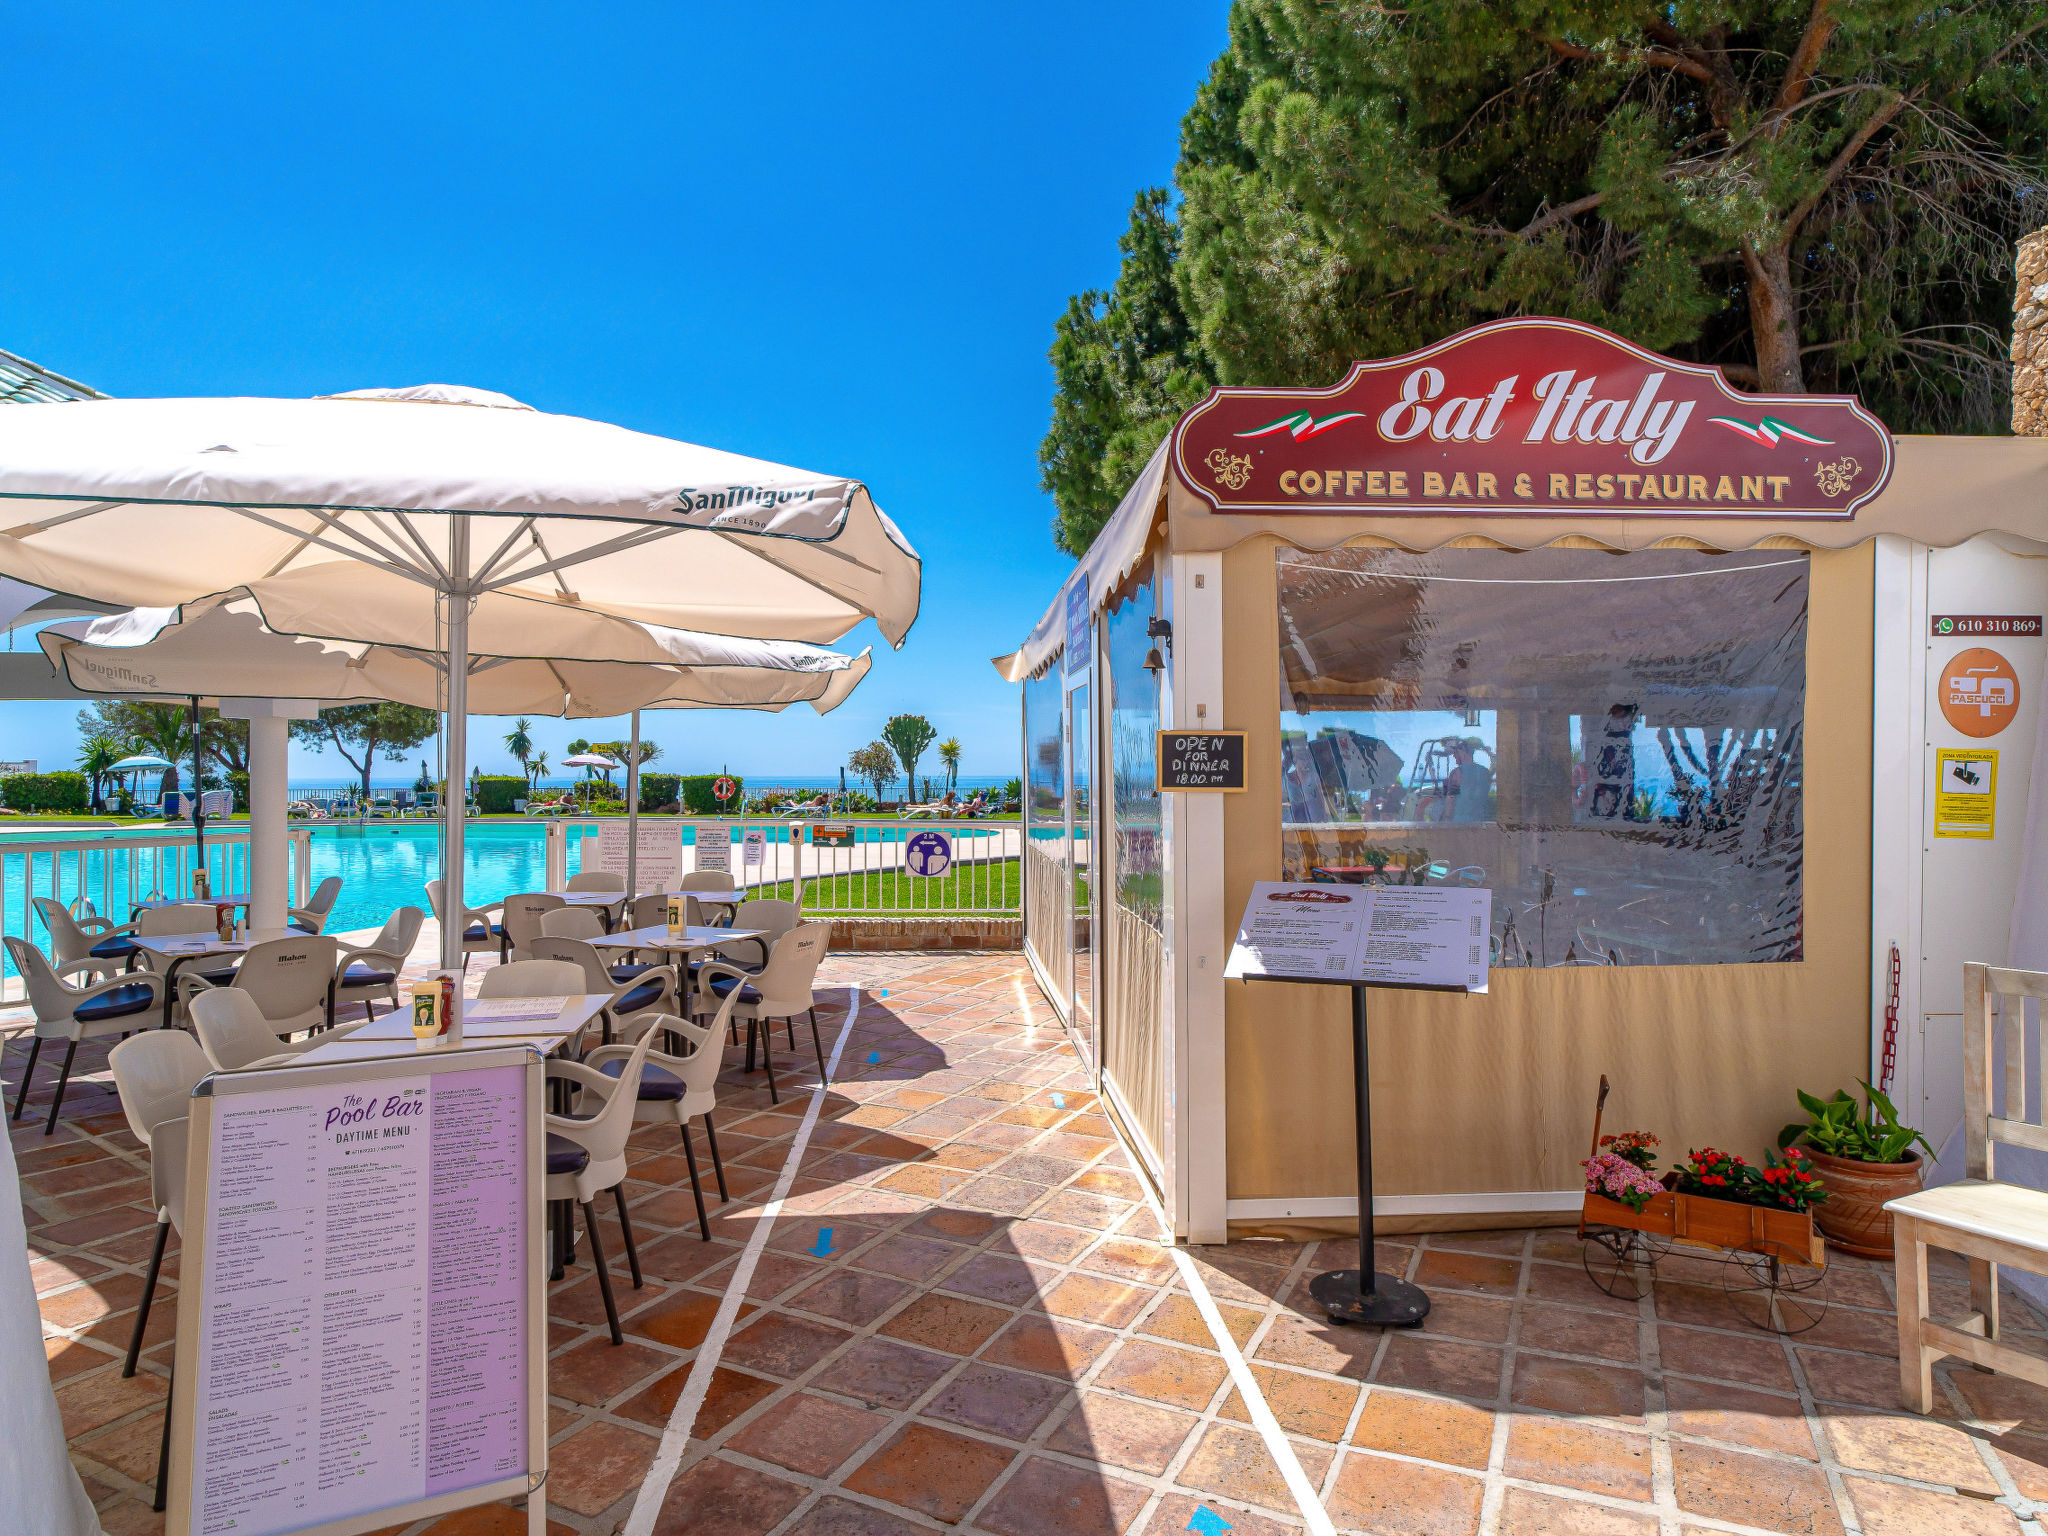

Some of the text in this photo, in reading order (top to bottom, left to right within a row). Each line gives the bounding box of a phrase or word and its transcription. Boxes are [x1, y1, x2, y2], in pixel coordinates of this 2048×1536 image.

[1378, 366, 1697, 465] Eat Italy
[1278, 469, 1791, 503] COFFEE BAR & RESTAURANT
[1958, 620, 2036, 632] 610 310 869
[790, 655, 832, 668] SanMi
[1951, 694, 2006, 705] PASCUCCI
[1175, 736, 1225, 752] OPEN
[1184, 751, 1209, 761] FOR
[1171, 758, 1230, 772] DINNER
[277, 954, 307, 963] Mahou
[343, 1094, 363, 1108] The
[325, 1095, 424, 1132] Pool Bar
[336, 1125, 411, 1144] DAYTIME MENU
[213, 1302, 232, 1310] WRAPS
[208, 1408, 229, 1416] SALADS
